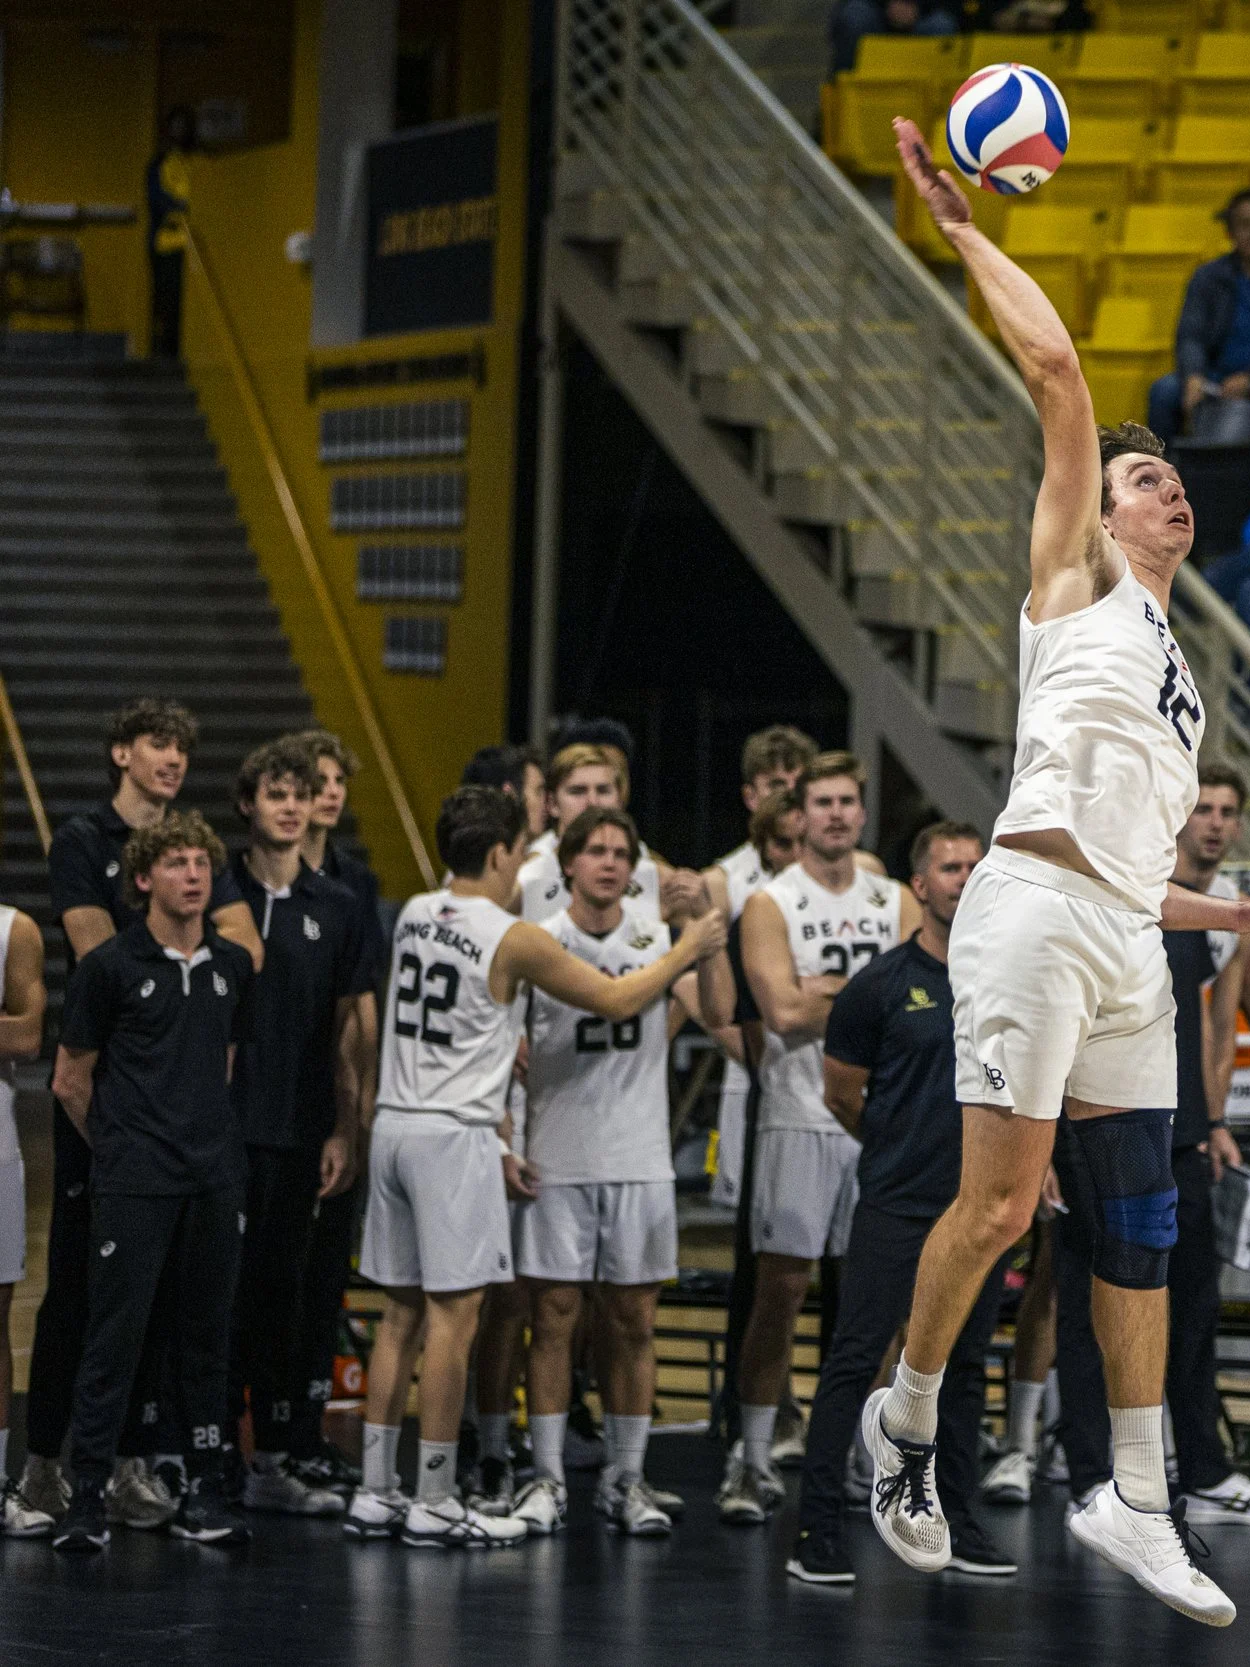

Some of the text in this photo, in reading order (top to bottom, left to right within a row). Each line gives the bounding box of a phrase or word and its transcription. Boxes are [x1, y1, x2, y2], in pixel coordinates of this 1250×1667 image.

[802, 918, 893, 941] BEACH
[433, 925, 482, 965] BEACH
[396, 952, 460, 1048] 22
[983, 1063, 1006, 1090] LB
[193, 1424, 221, 1449] 28
